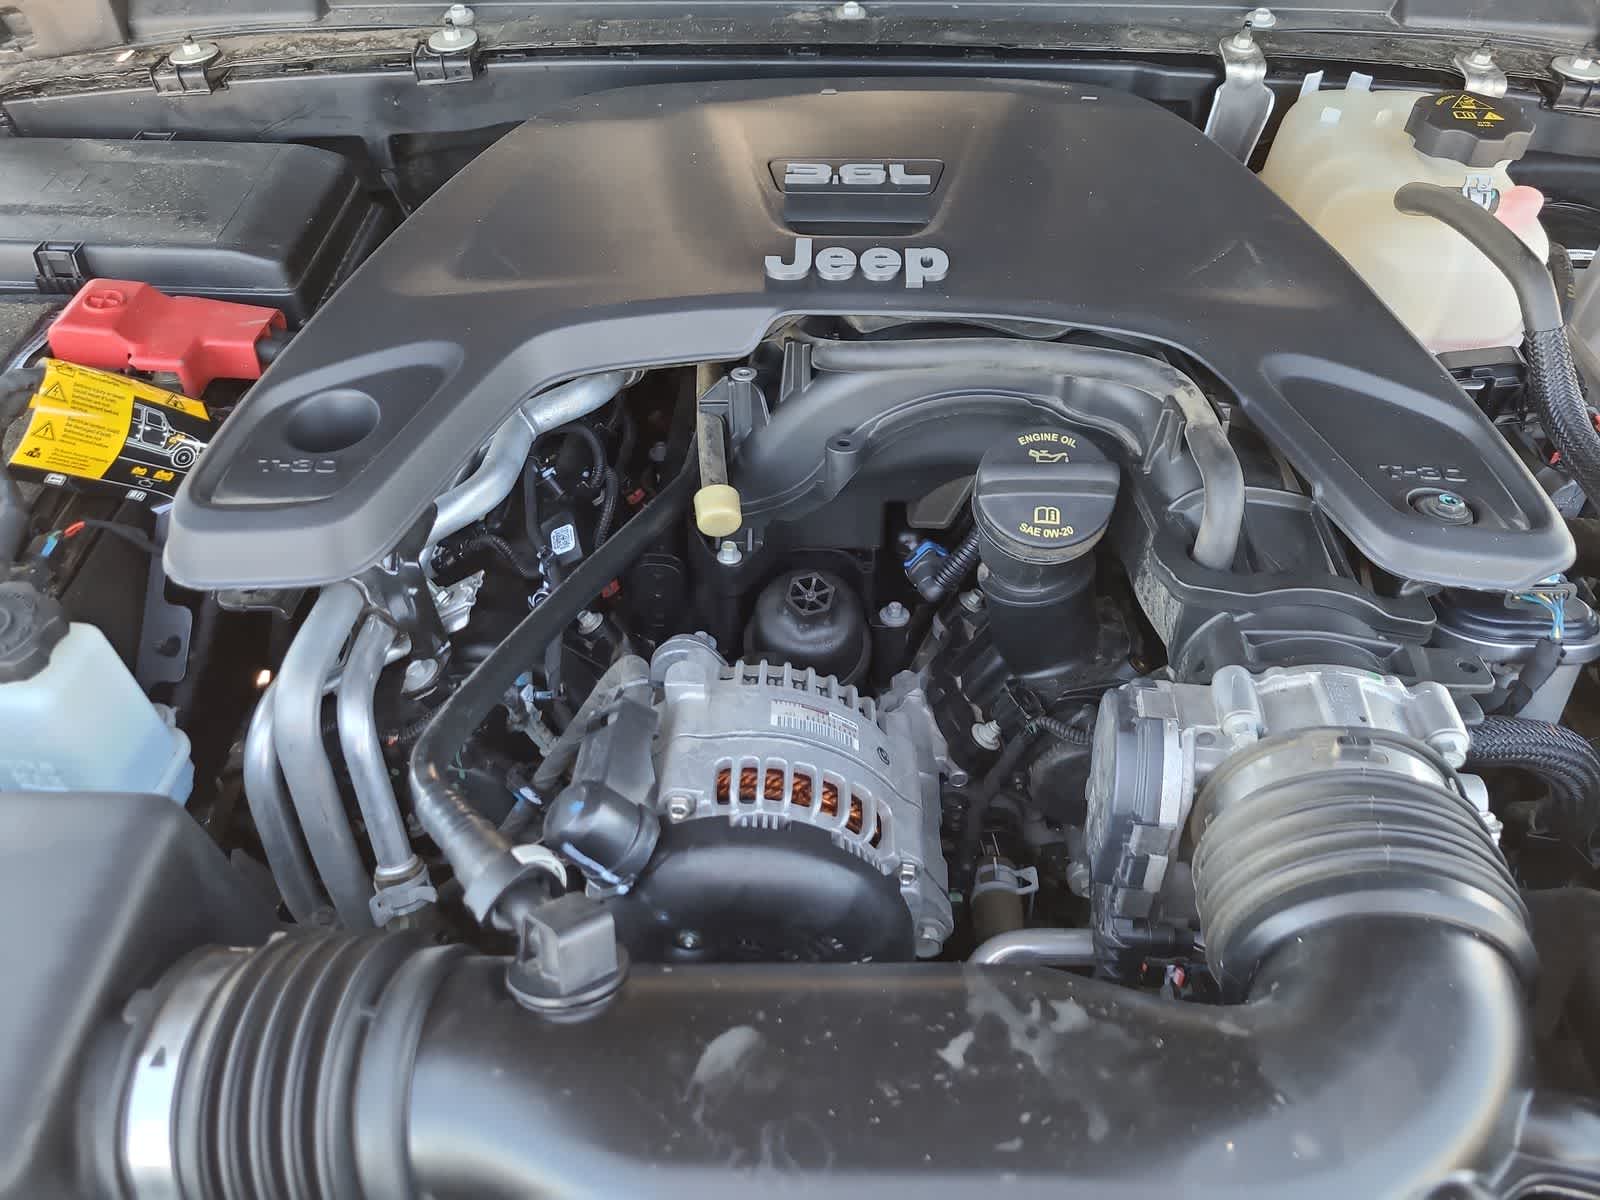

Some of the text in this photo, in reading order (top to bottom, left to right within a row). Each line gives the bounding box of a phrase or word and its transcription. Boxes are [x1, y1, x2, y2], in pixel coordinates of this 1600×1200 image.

[784, 163, 931, 185] 3.6L
[765, 238, 949, 288] Jeep
[1018, 432, 1077, 449] ENGINE OIL
[1019, 522, 1074, 538] SAE 0W-20
